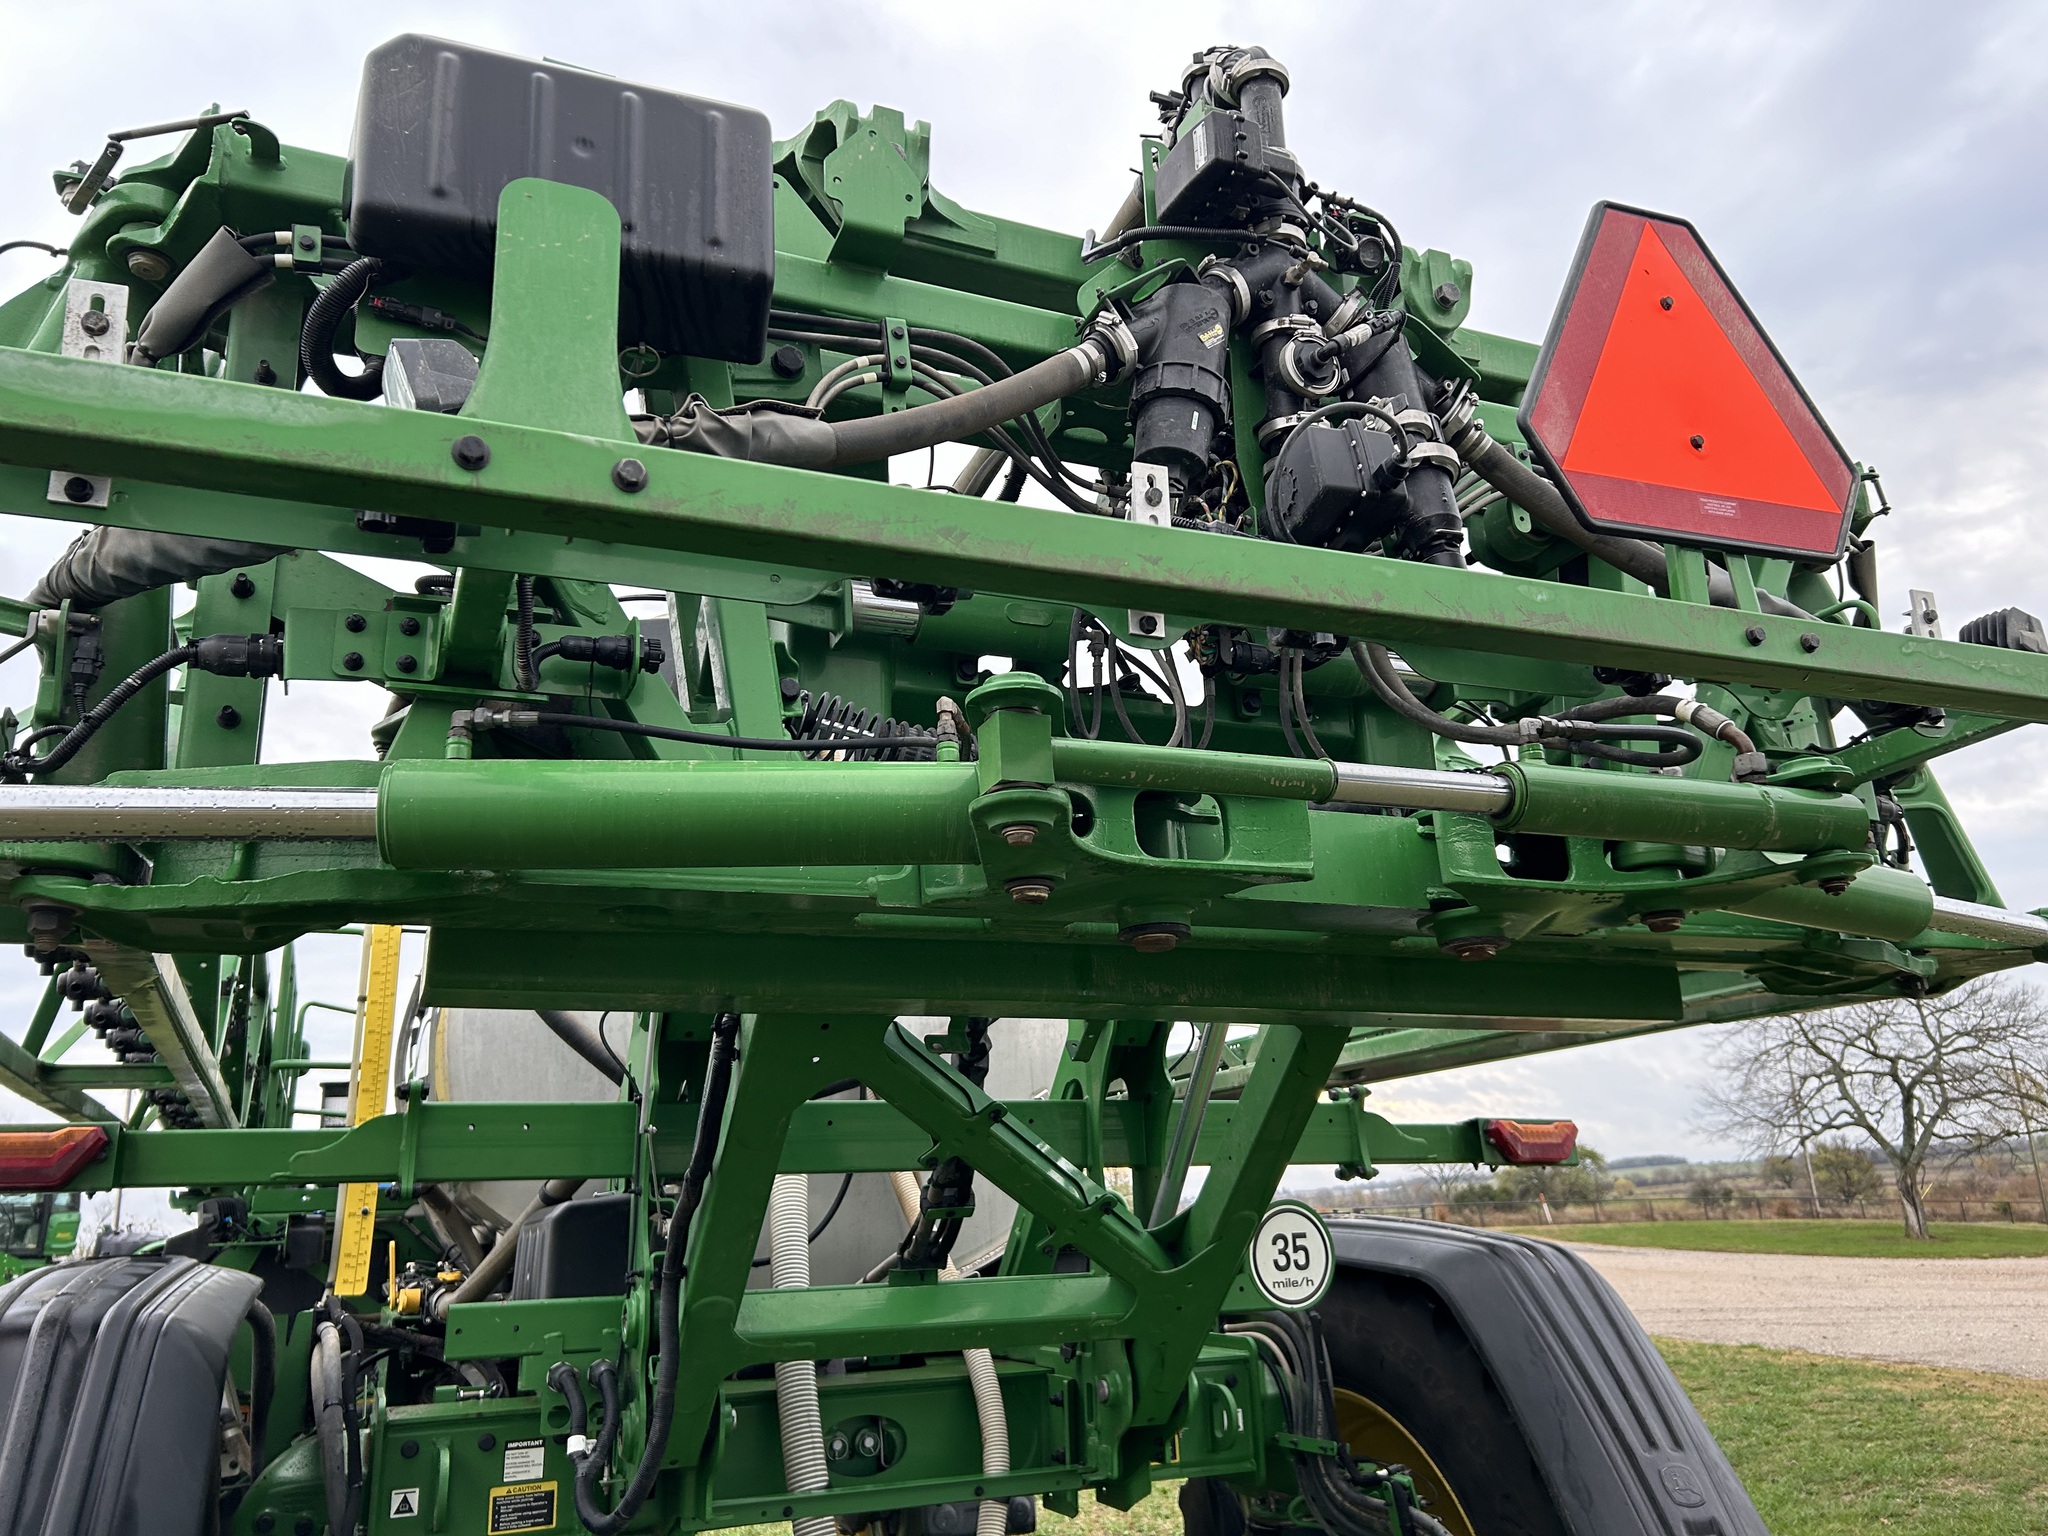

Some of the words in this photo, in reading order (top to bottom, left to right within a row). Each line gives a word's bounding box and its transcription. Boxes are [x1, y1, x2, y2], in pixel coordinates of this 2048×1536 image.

[1271, 1232, 1310, 1272] 35
[1272, 1277, 1314, 1288] mile/h
[508, 1440, 543, 1448] IMPORTANT
[512, 1484, 542, 1493] CAUTION
